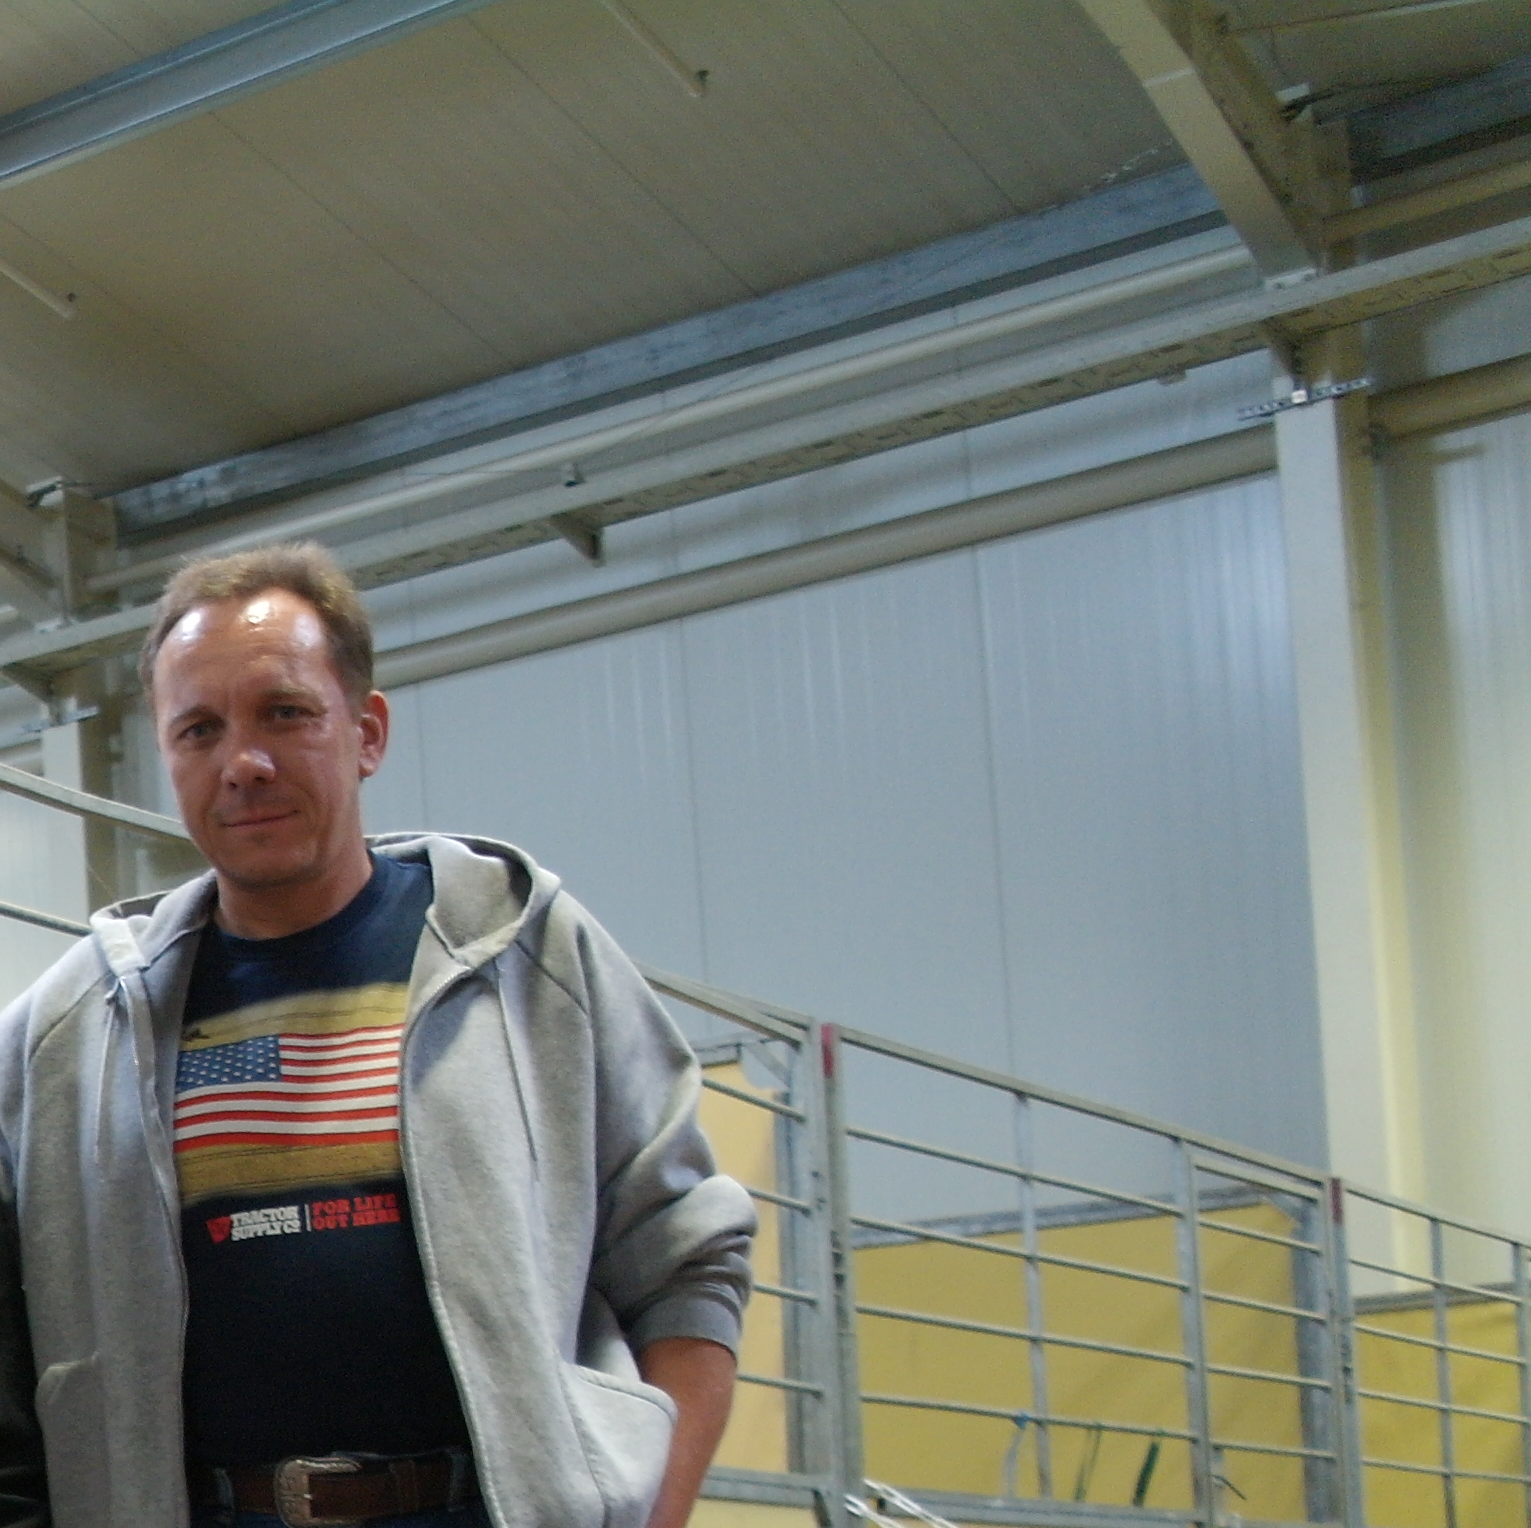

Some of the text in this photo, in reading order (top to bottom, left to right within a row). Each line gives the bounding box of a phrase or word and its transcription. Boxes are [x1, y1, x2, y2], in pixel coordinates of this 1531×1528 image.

[312, 1193, 397, 1216] FOR LIFE
[230, 1205, 299, 1226] TRACTOR
[312, 1213, 349, 1231] OUT
[231, 1223, 283, 1242] SUPPLY
